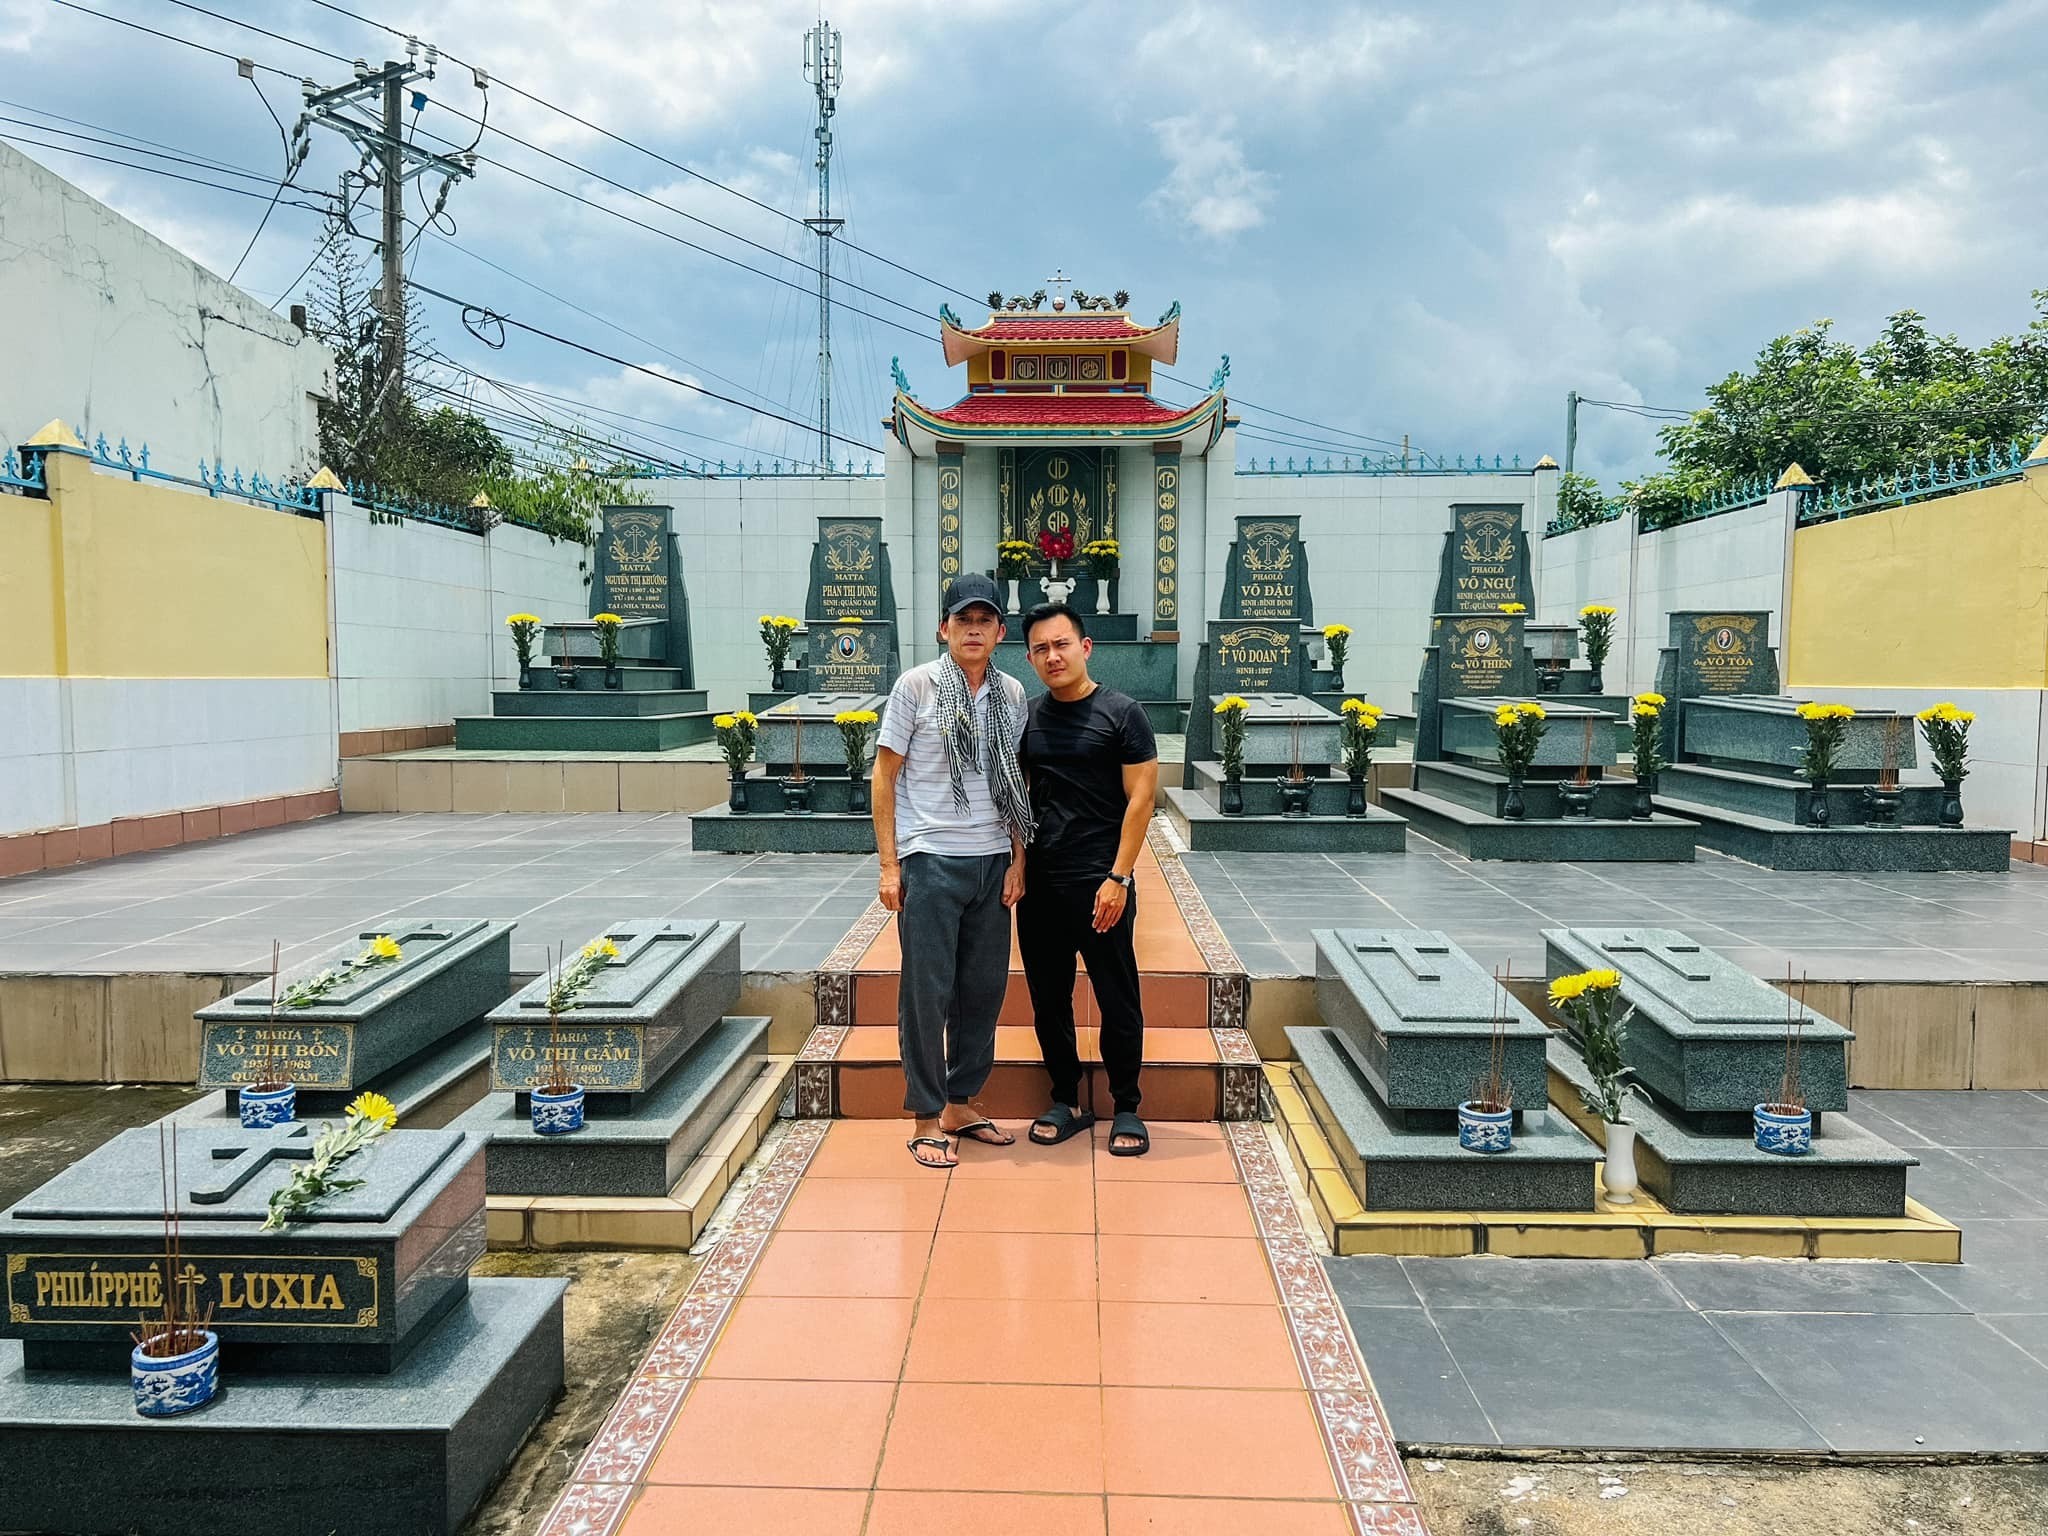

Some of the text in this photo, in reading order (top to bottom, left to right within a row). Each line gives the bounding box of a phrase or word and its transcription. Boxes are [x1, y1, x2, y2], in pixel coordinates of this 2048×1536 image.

[620, 564, 651, 572] MATTA
[1252, 572, 1283, 580] PHAOLÔ
[1241, 583, 1294, 598] VÕ ĐẬU
[1458, 576, 1516, 591] VÕ NGỰ
[822, 586, 842, 596] PHAN
[842, 586, 856, 598] THỊ
[1232, 647, 1278, 663] VÕ DOAN
[1707, 656, 1724, 666] VÕ
[1728, 656, 1754, 666] TÒA
[824, 663, 836, 674] VÕ
[838, 665, 854, 676] THỊ
[1465, 658, 1480, 668] VÕ
[216, 1042, 246, 1056] VÕ
[251, 1044, 288, 1059] THỊ
[508, 1045, 536, 1060] VÕ
[541, 1048, 578, 1064] THỊ
[35, 1261, 346, 1309] PHILÍPPHÊ LUXIA
